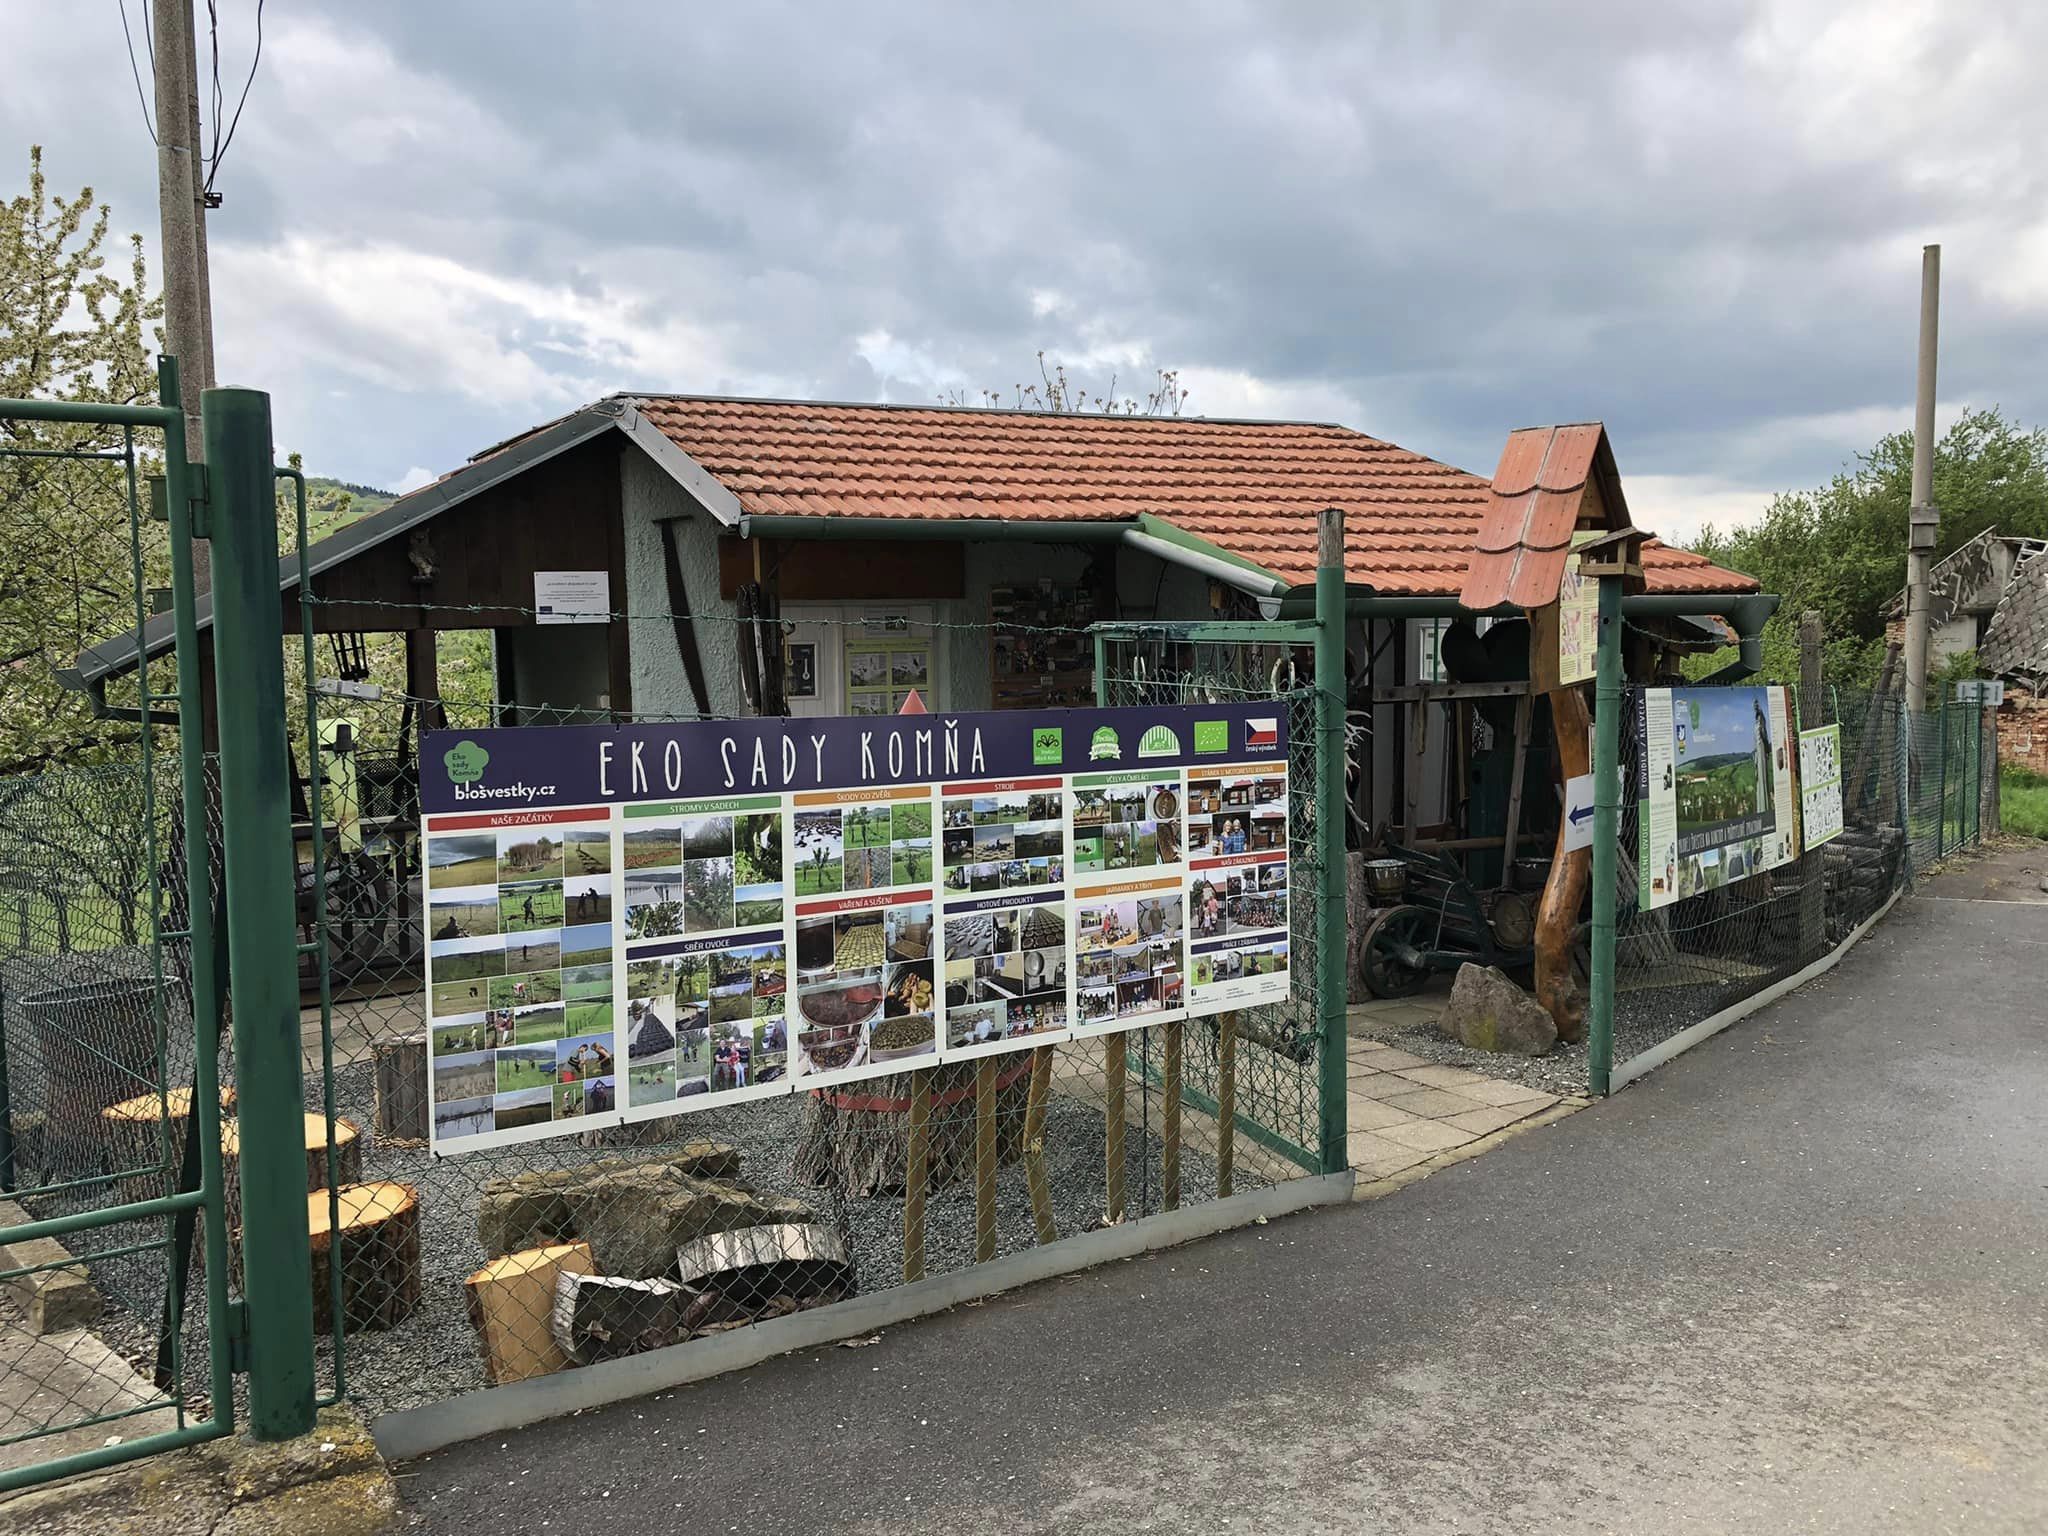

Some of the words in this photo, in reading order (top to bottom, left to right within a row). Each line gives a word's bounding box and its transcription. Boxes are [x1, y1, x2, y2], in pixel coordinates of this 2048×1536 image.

[600, 740, 682, 796] EKO
[720, 734, 827, 788] SADY
[861, 719, 985, 780] KOMŇA
[452, 761, 469, 769] sady
[994, 782, 1016, 792] STROJE
[837, 791, 858, 801] ŠKODY
[860, 792, 870, 800] OD
[670, 803, 702, 813] STROMY
[703, 803, 710, 811] V
[711, 801, 740, 810] SADECH
[491, 814, 514, 825] NAŠE
[515, 813, 554, 824] ZAČÁTKY
[864, 899, 869, 907] A
[977, 899, 1000, 909] HOTOVÉ
[1002, 896, 1034, 907] PRODUKTY
[684, 941, 704, 952] SBĚR
[705, 939, 730, 949] OVOCE
